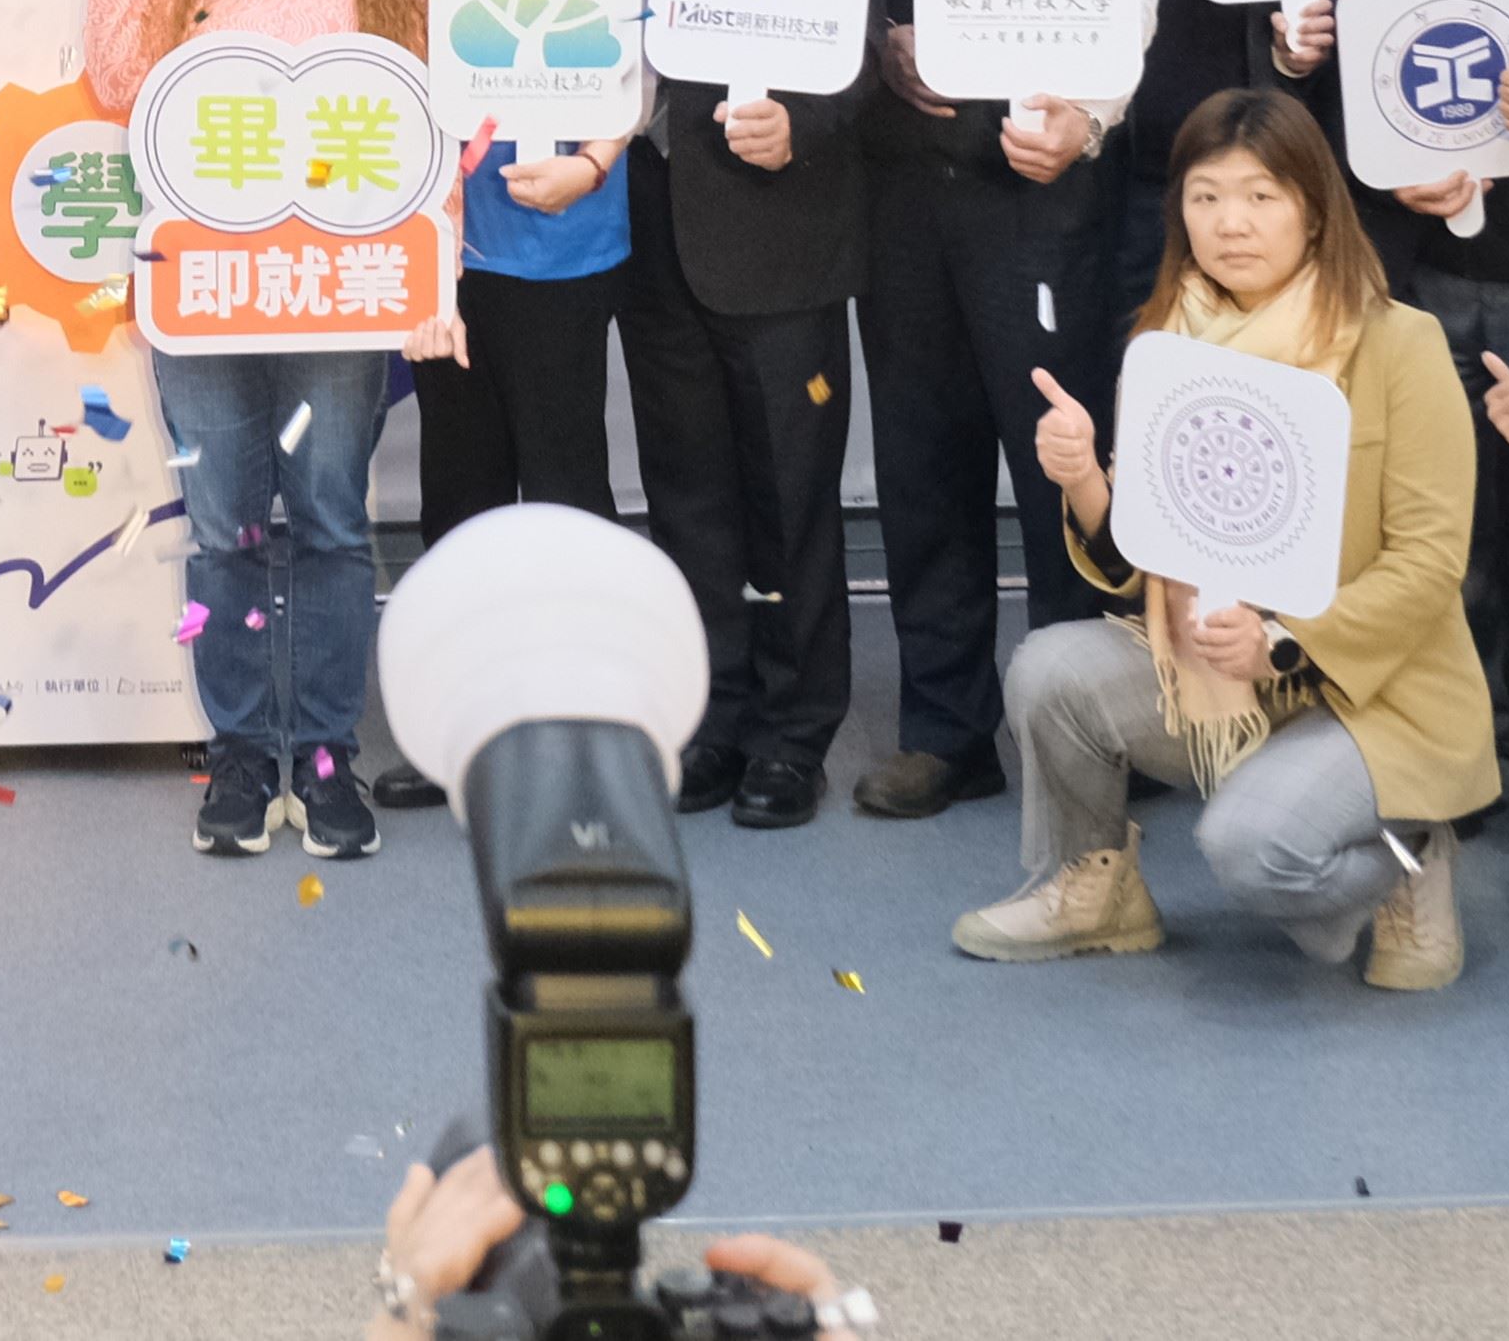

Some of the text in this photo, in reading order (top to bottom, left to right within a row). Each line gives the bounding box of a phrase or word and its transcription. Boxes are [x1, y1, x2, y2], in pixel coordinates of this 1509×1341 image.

[735, 11, 839, 37] 明新科技大學
[189, 94, 401, 194] 畢業
[38, 149, 143, 261] 學
[177, 242, 409, 320] 即就業
